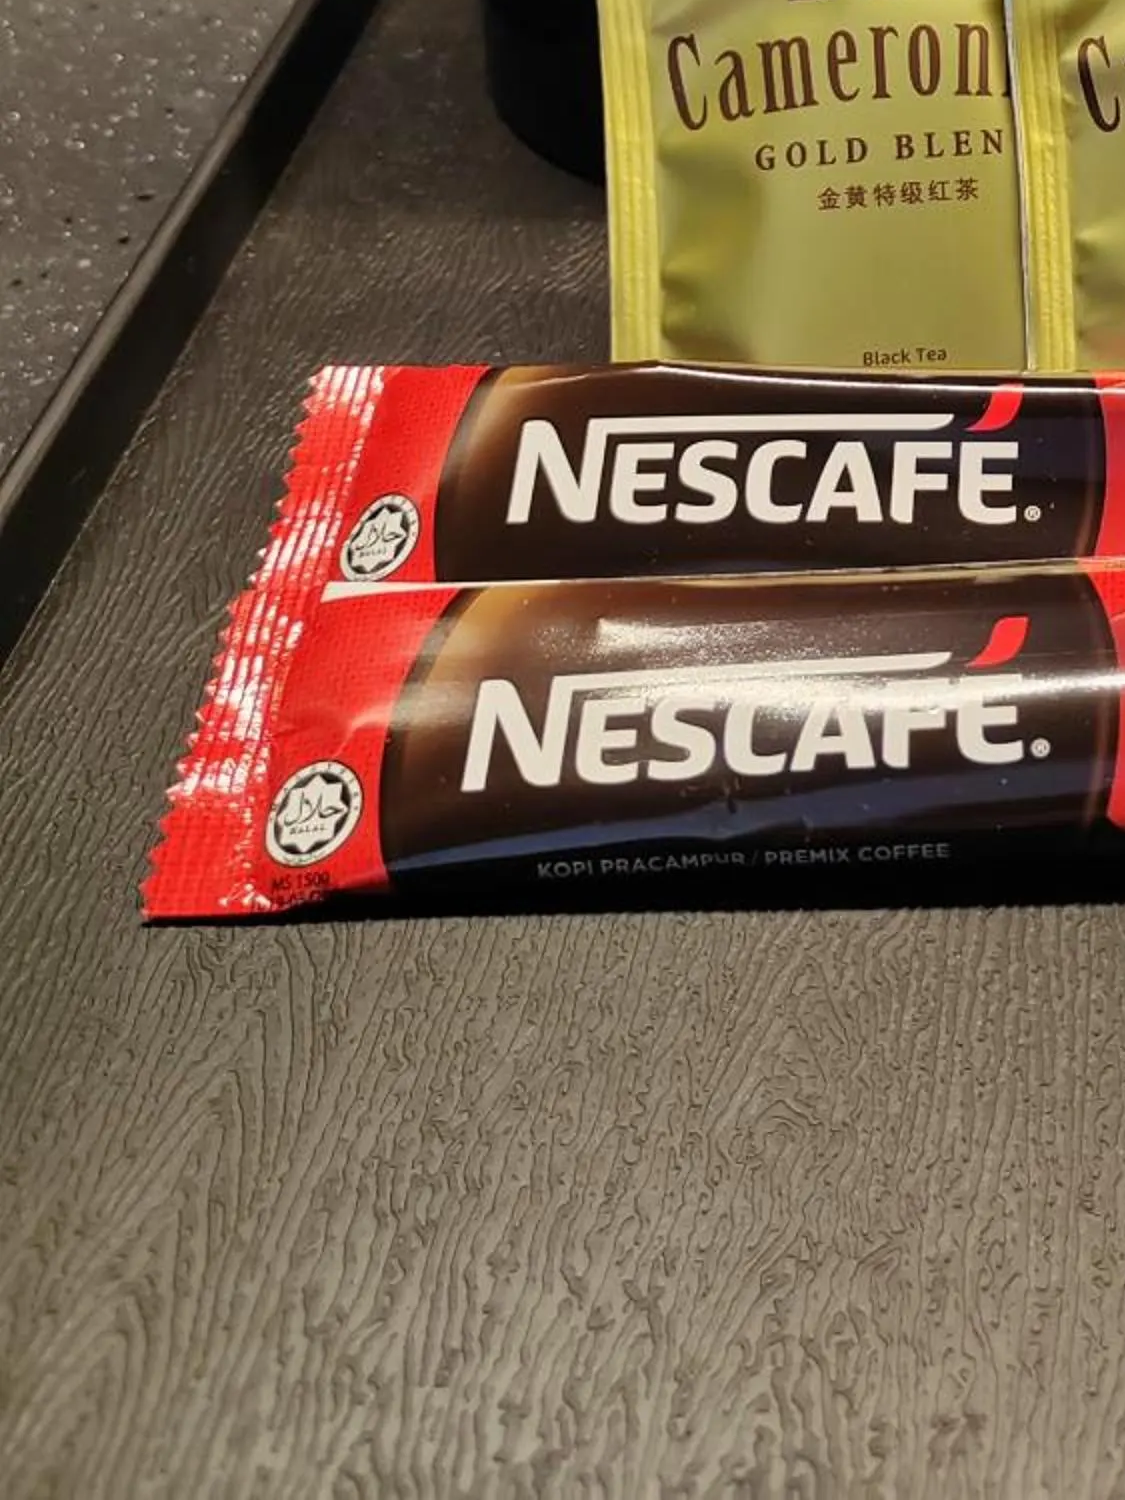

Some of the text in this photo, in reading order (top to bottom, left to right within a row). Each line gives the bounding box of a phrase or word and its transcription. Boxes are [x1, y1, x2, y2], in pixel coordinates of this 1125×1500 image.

[667, 22, 1010, 132] Cameron
[755, 135, 868, 171] GOLD
[817, 178, 980, 212] 金黄特级红茶
[862, 346, 947, 367] Black Tea
[537, 859, 594, 879] KOPI
[600, 851, 746, 875] PRACAMPUR
[764, 847, 850, 866] PREMIX
[858, 843, 951, 862] COFFEE
